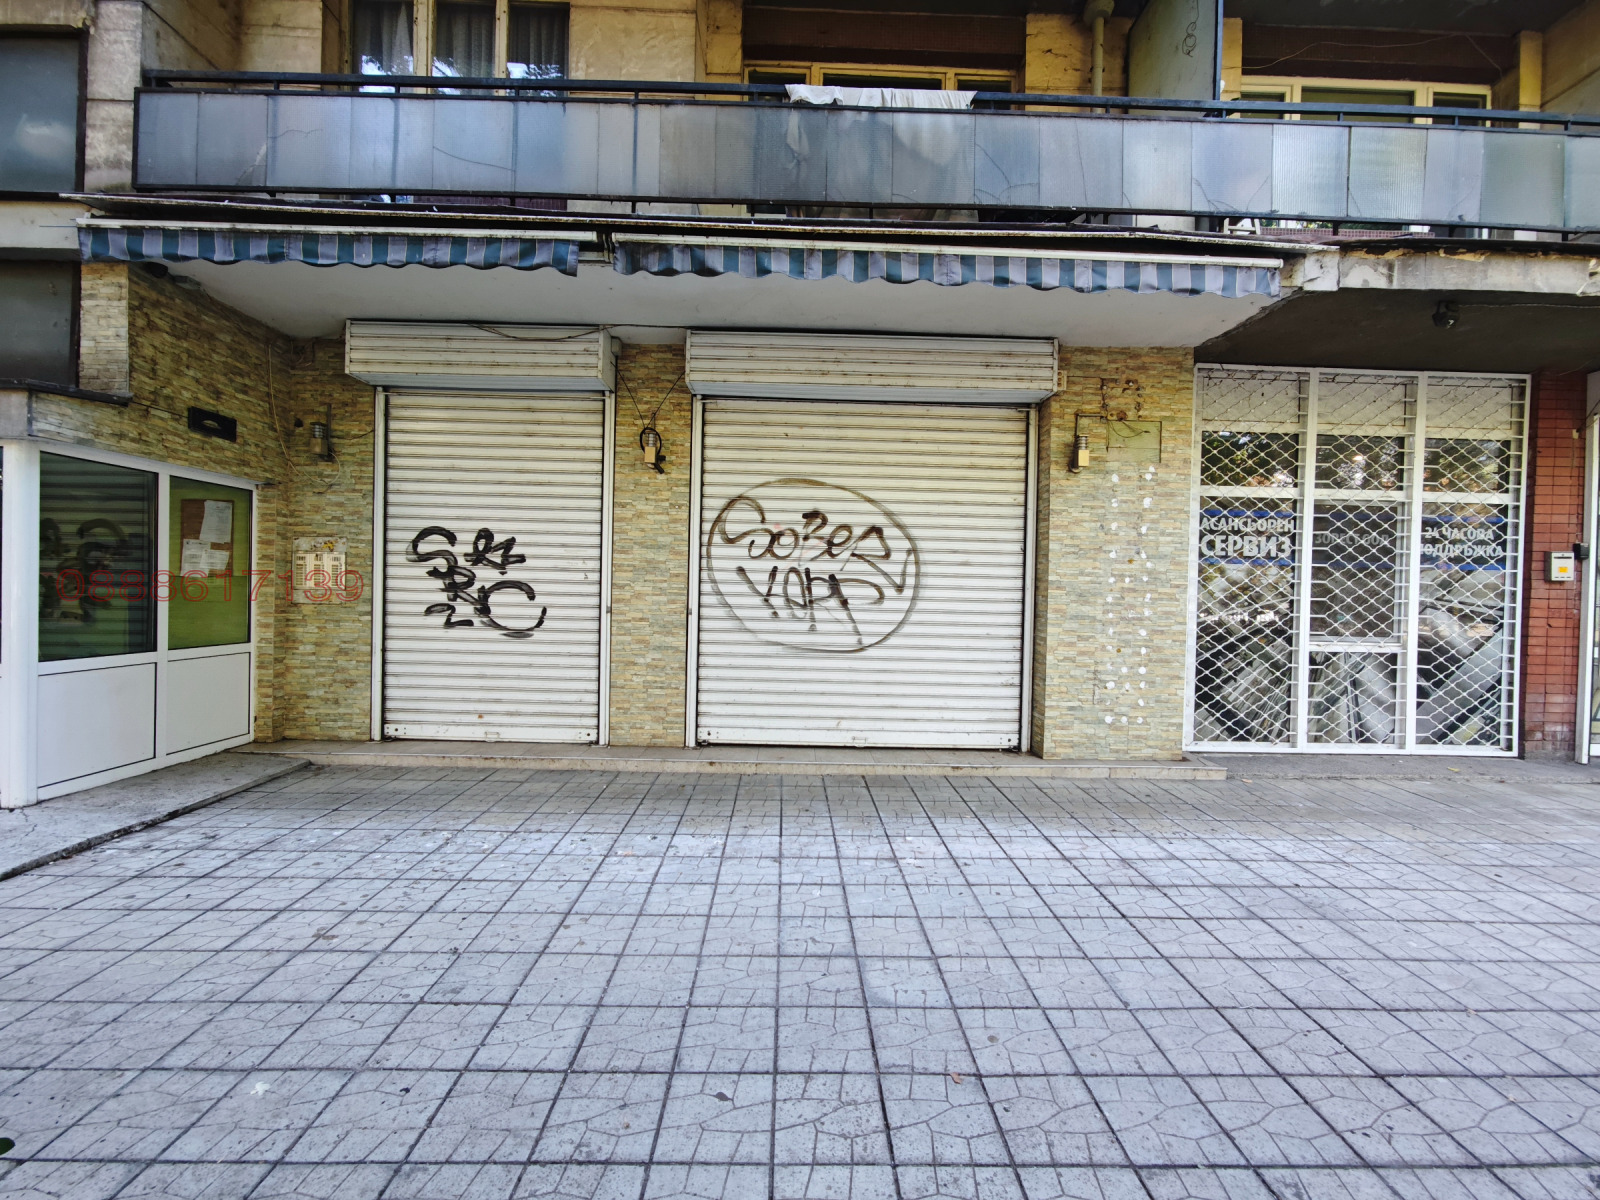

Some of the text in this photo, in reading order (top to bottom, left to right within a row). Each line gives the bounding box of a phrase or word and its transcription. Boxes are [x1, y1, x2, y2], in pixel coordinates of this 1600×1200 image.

[1200, 517, 1295, 532] АСАНСЬОРЕН
[1424, 526, 1495, 540] 24 ЧАСОВА
[1200, 534, 1293, 557] СЕРВИЗ
